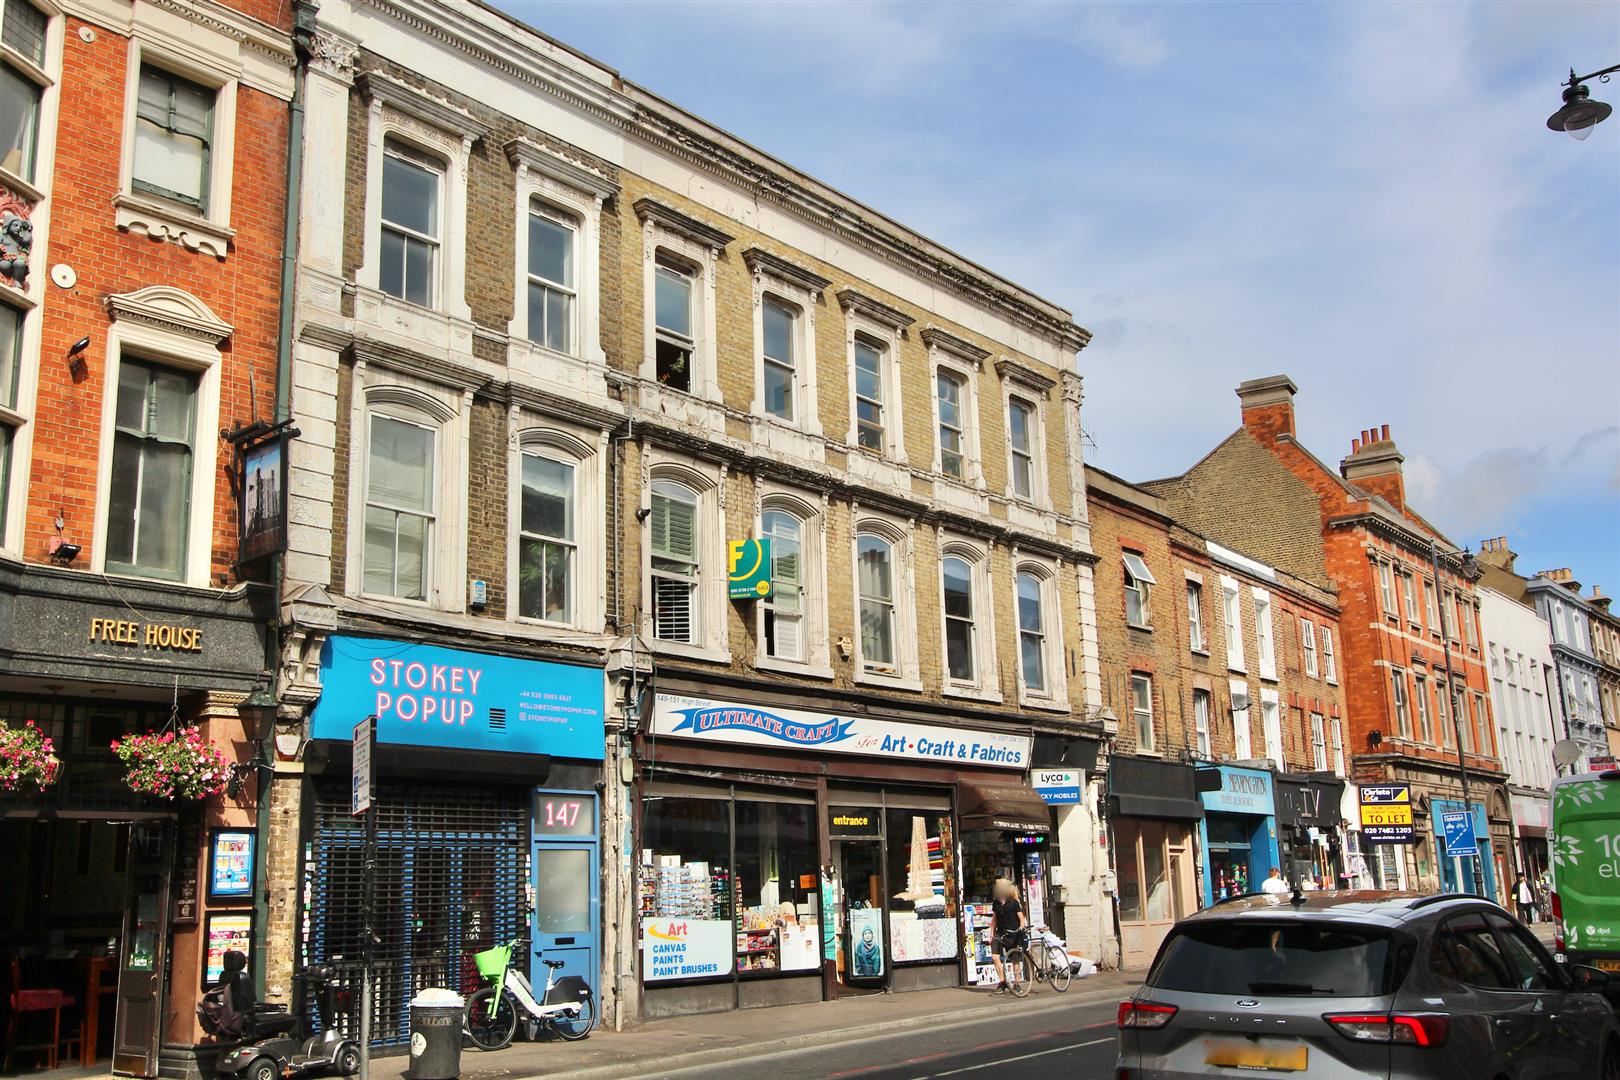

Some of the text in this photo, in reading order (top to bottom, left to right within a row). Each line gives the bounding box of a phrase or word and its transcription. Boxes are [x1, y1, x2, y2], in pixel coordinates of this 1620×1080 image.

[90, 618, 203, 650] FREE HOUSE
[370, 658, 482, 695] STOKEY
[657, 695, 680, 703] 149-151
[681, 698, 695, 707] High
[376, 690, 475, 726] POPUP
[700, 710, 836, 742] ULTIMATE CRAFT
[880, 734, 906, 753] Art
[917, 737, 955, 757] Craft
[957, 743, 967, 758] &
[970, 743, 1021, 764] Fabrics
[1041, 773, 1063, 783] Lyca
[545, 801, 581, 827] 147
[833, 815, 868, 826] entrance
[1368, 815, 1406, 824] TO LET
[668, 922, 687, 936] Art
[1597, 927, 1611, 936] dpd
[652, 943, 687, 953] CANVAS
[653, 955, 683, 965] PAINTS
[653, 963, 718, 976] PAINT BRUSHES
